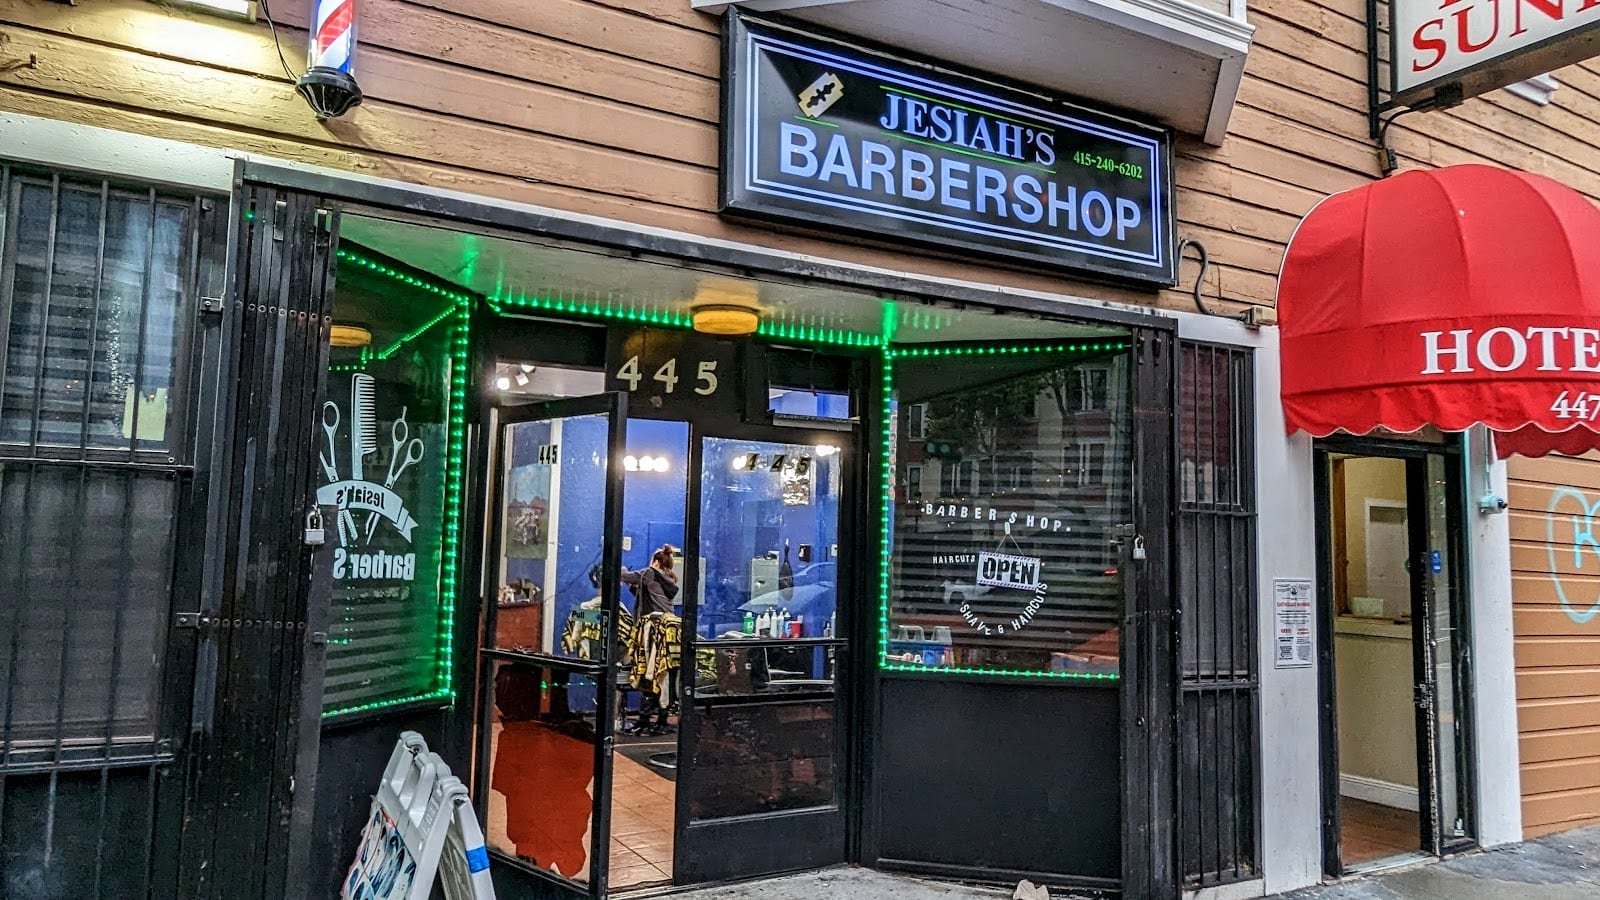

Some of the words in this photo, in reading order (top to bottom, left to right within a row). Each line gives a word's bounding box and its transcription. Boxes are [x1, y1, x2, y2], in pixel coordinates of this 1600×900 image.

[880, 92, 1056, 167] JESIAH'S
[1073, 150, 1143, 180] 415-240-6202
[779, 121, 1142, 242] BARBERSHOP
[539, 445, 558, 465] 445
[932, 554, 976, 564] HAIRCUTS
[982, 557, 1036, 586] OPEN
[960, 603, 992, 636] SHAVE
[1011, 581, 1048, 631] HAIRCUTS
